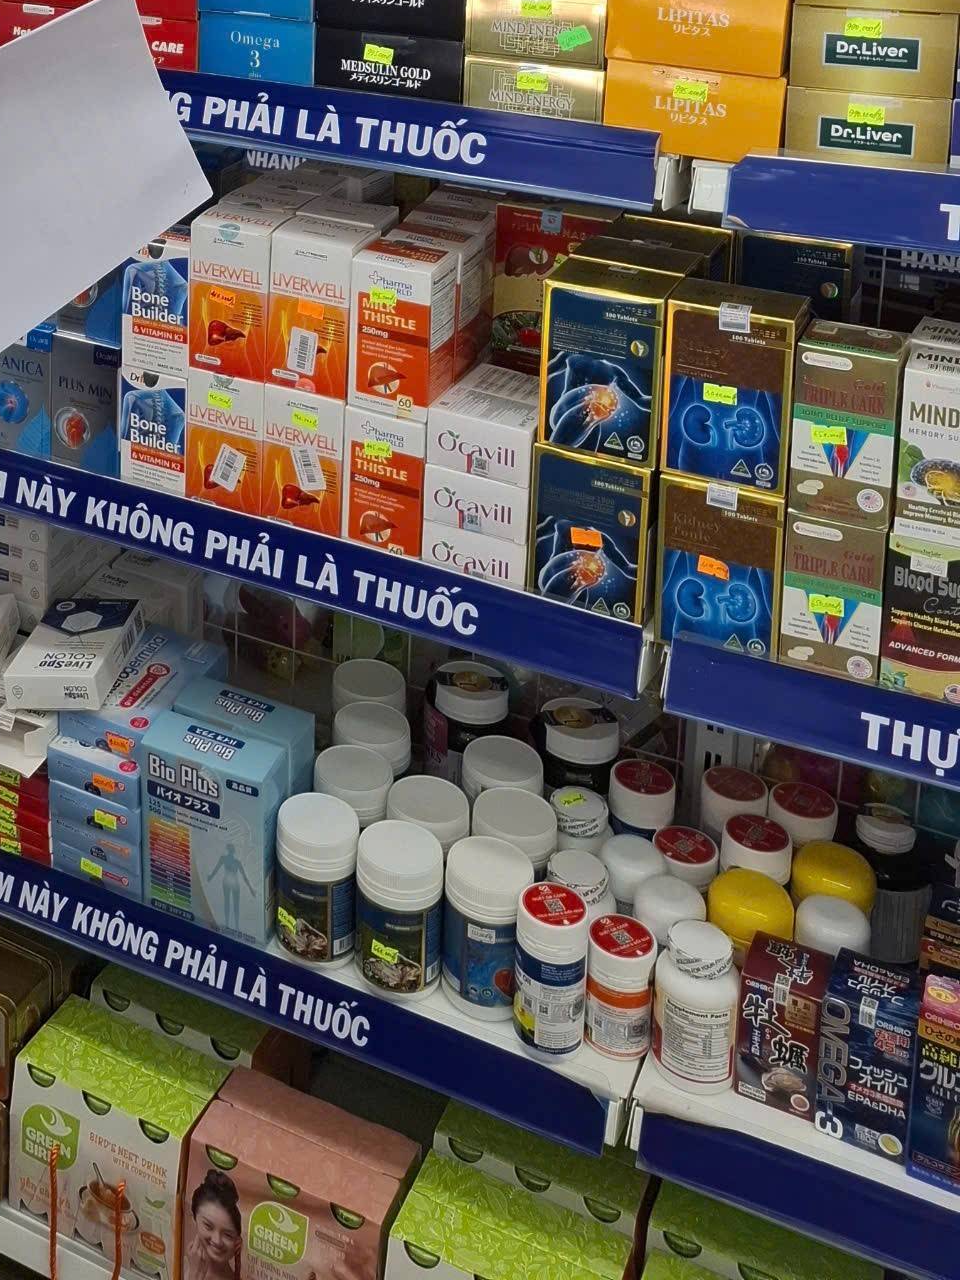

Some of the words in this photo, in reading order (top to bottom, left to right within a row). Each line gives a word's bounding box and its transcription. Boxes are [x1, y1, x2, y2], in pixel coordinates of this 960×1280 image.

[202, 91, 284, 136] PHẢI
[296, 93, 341, 145] LÀ
[356, 115, 488, 166] THUỐC
[192, 260, 263, 287] LIVERWELL
[131, 287, 169, 306] Bone
[131, 303, 184, 326] Builder
[362, 309, 417, 332] THISTLE
[605, 311, 618, 320] 100
[618, 312, 639, 324] Tablets
[141, 327, 170, 341] VITAMIN
[172, 332, 185, 342] K2
[361, 325, 389, 339] 250mg
[58, 374, 86, 394] PLUS
[88, 382, 113, 400] MIN
[397, 397, 412, 409] 60
[909, 400, 960, 429] MIND
[908, 427, 946, 440] MEMORY
[16, 474, 76, 514] NÀY
[84, 502, 194, 553] KHÔNG
[205, 531, 284, 580] PHẢI
[295, 554, 340, 596] LÀ
[352, 569, 479, 637] THUỐC
[44, 650, 98, 660] COLON
[889, 641, 936, 657] ADVANCED
[19, 878, 69, 922] NÀY
[71, 902, 159, 960] KHÔNG
[164, 937, 227, 992] PHẢI
[234, 964, 268, 1005] LÀ
[278, 985, 372, 1048] THUỐC
[745, 979, 774, 993] ORIHIRO
[667, 999, 709, 1019] Supplement
[858, 1073, 899, 1097] オイル
[847, 1092, 906, 1120] EPA&DHA
[25, 1125, 73, 1160] GREEN
[253, 1239, 284, 1261] BIRD
